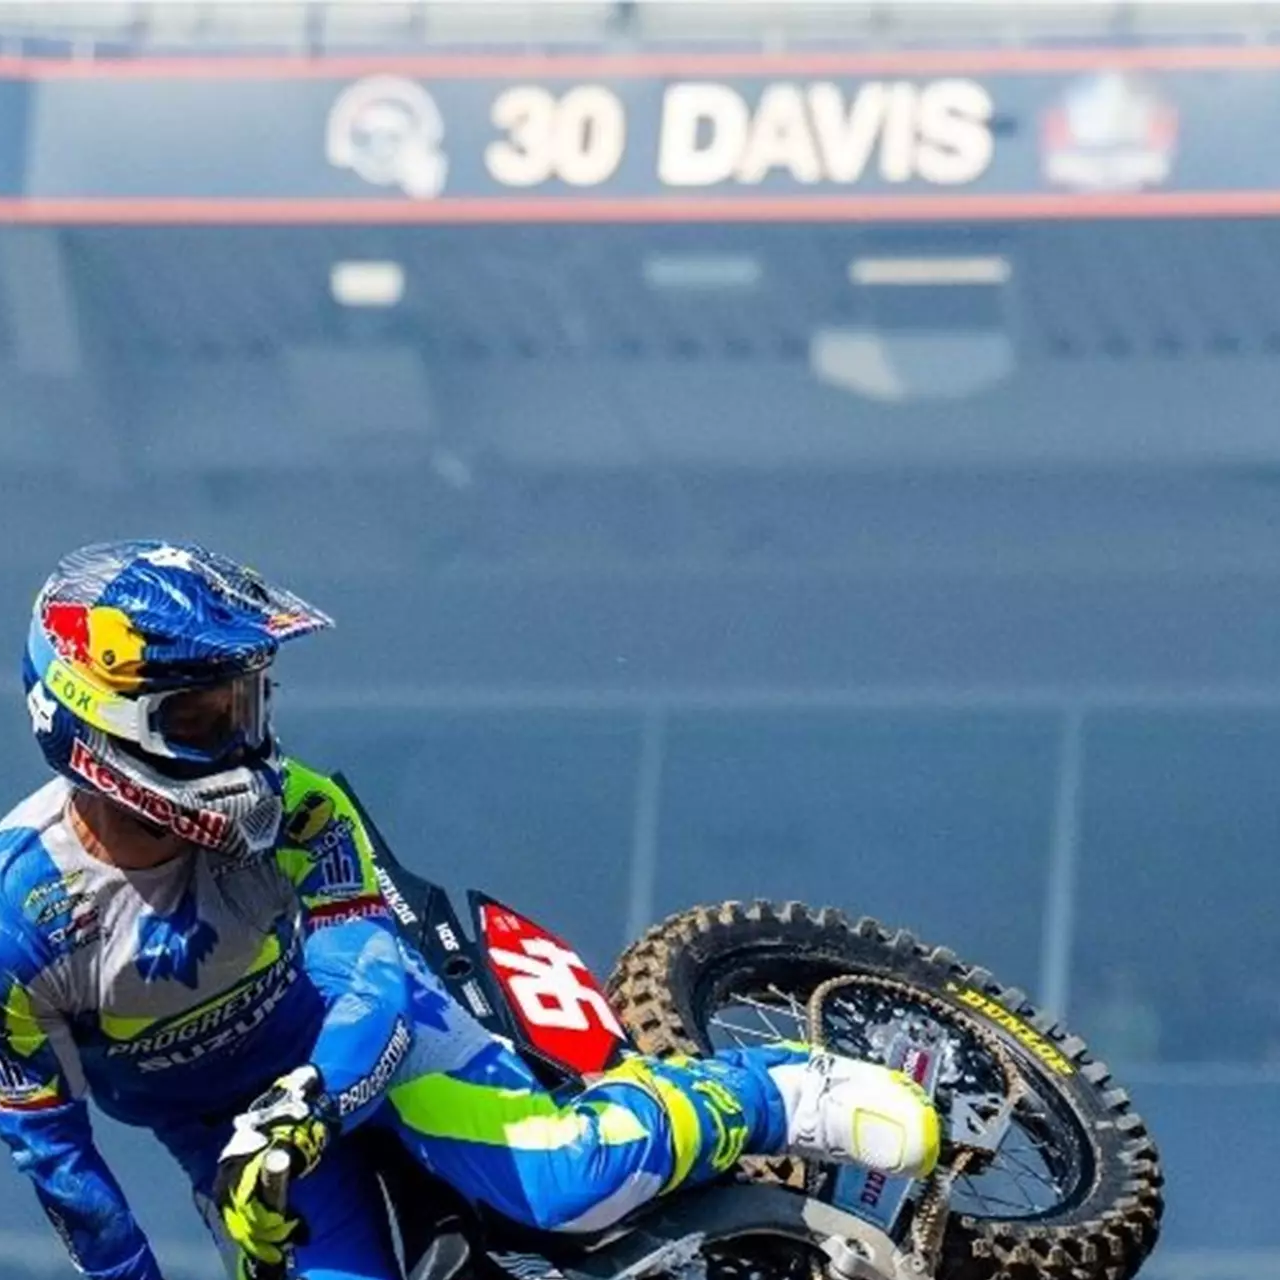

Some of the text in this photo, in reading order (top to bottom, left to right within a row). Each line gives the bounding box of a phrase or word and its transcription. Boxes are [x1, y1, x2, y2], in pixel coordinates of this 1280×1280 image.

[485, 78, 996, 187] 30 DAVIS
[47, 668, 93, 713] FOX
[963, 986, 1075, 1077] DUNLOP
